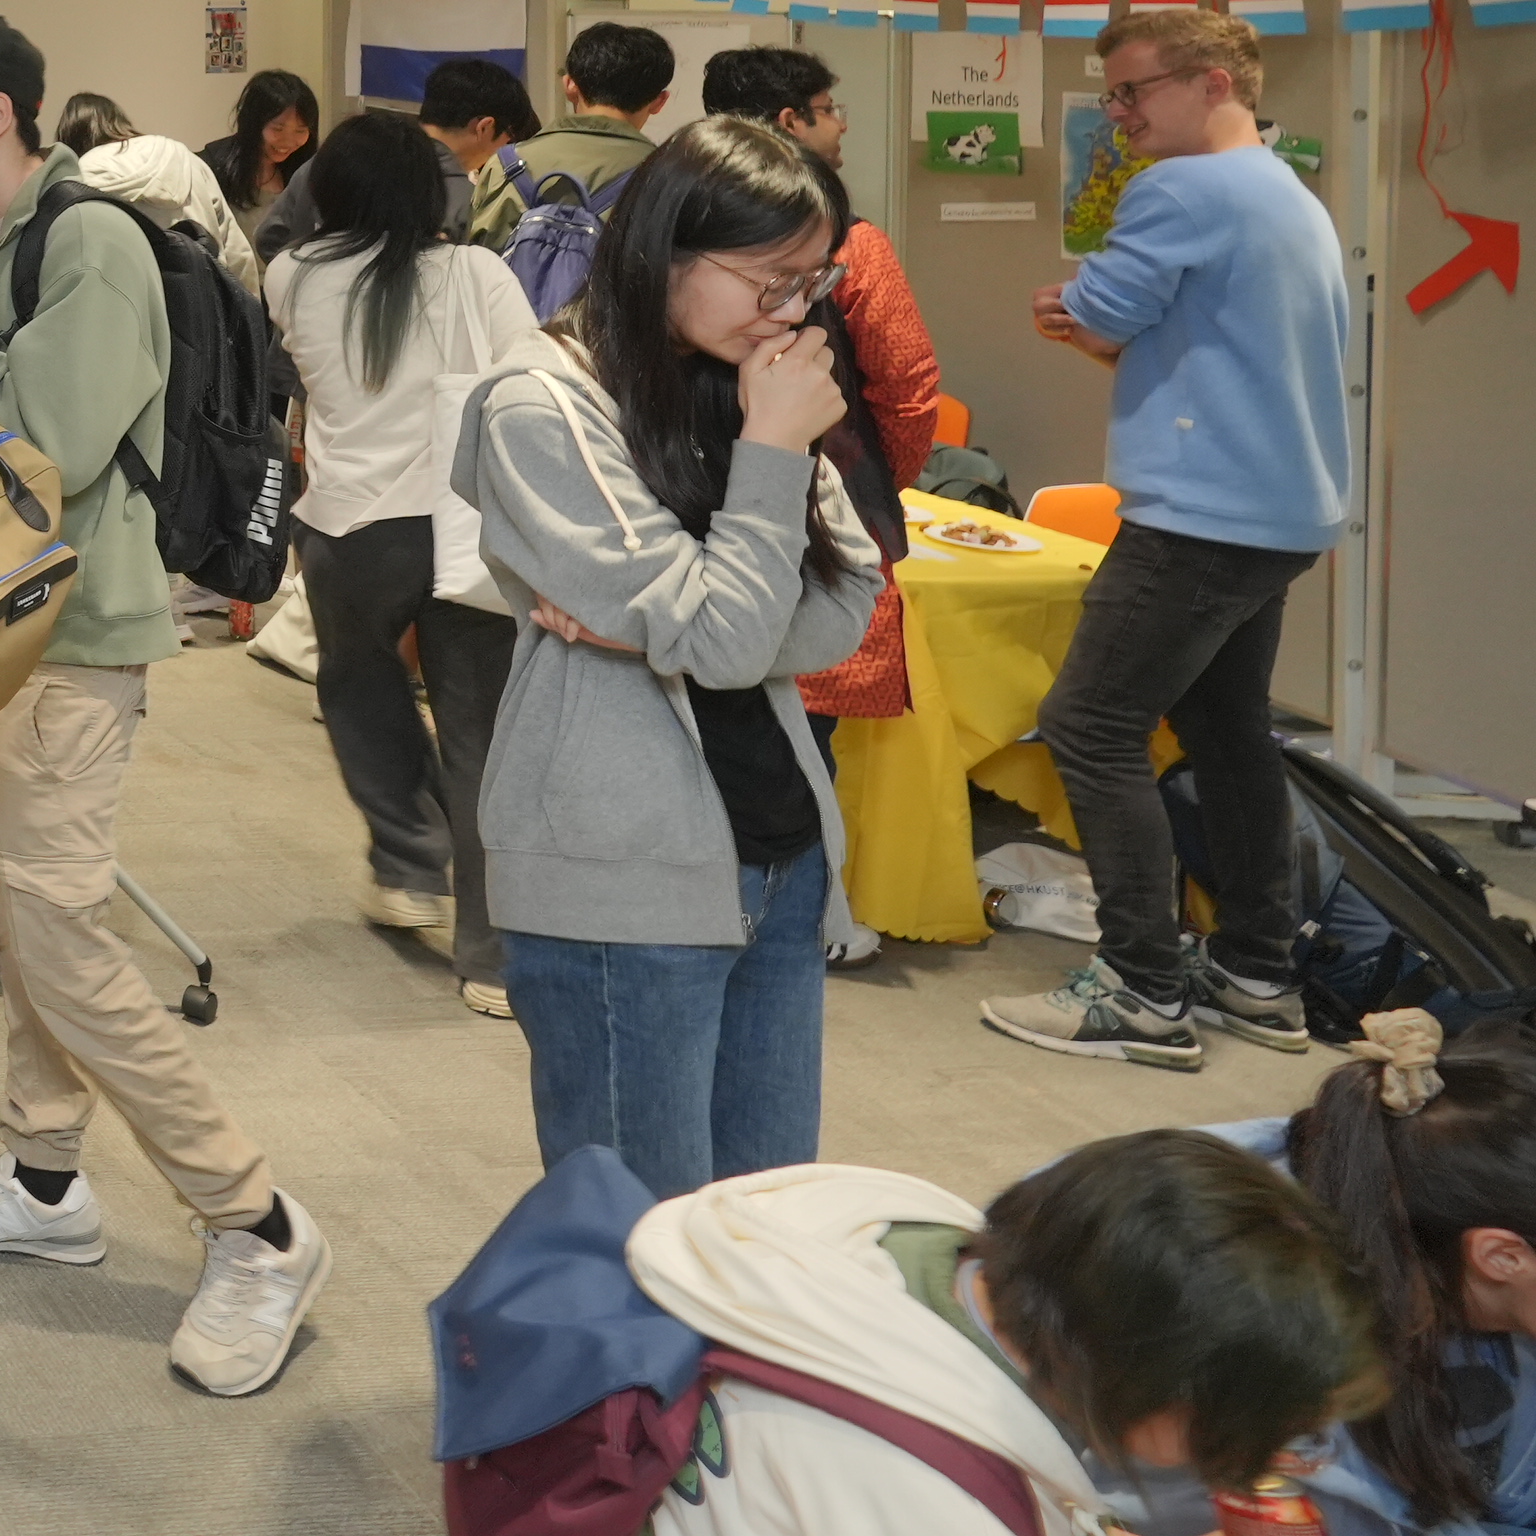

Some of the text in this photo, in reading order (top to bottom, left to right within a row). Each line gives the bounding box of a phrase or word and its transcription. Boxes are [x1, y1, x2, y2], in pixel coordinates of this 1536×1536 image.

[961, 66, 989, 82] The
[931, 90, 1019, 108] Netherlands
[247, 458, 283, 546] PUMA
